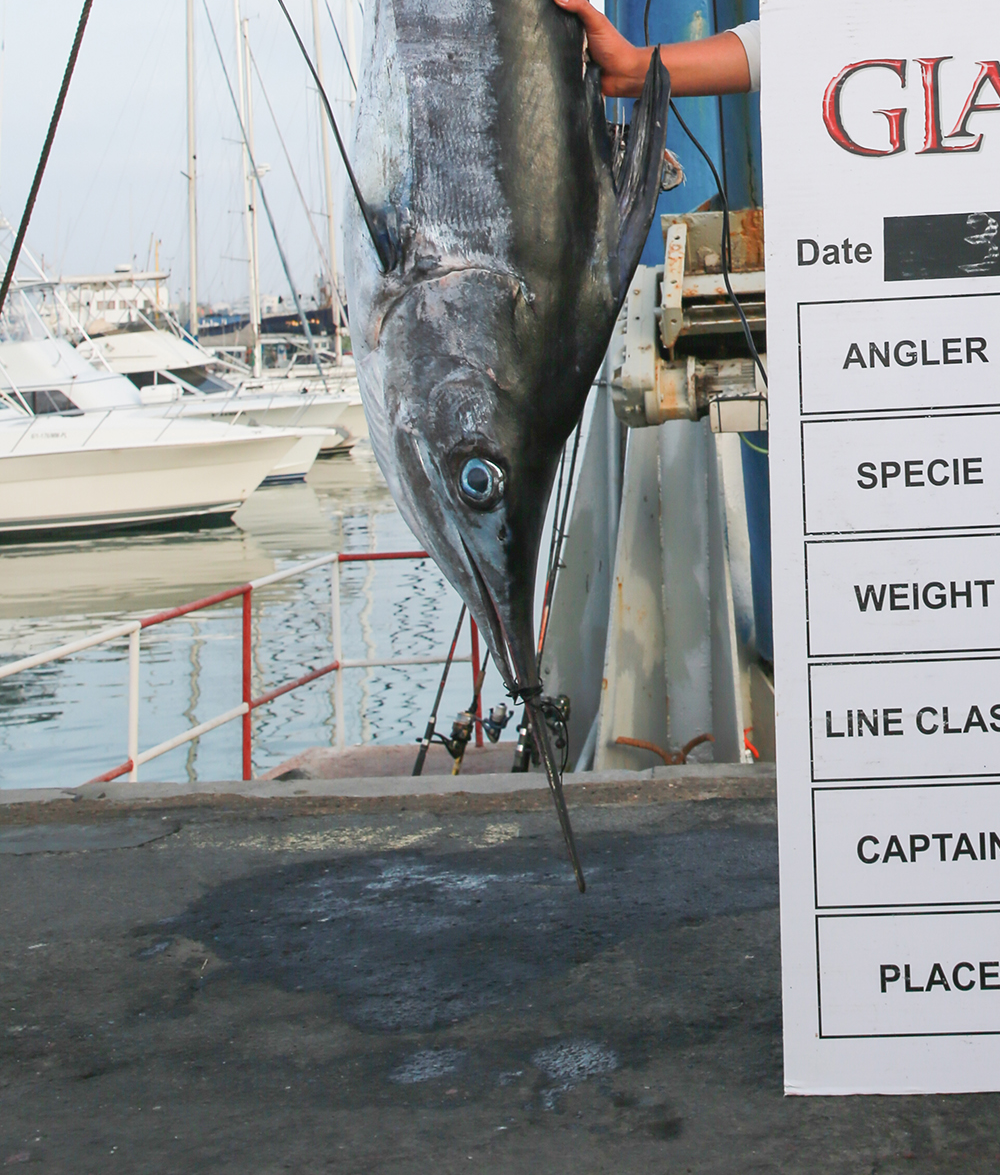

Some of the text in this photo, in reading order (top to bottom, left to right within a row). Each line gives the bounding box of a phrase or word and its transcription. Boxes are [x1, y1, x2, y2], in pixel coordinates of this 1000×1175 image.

[796, 237, 873, 267] Date
[842, 336, 990, 370] ANGLER
[856, 457, 984, 490] SPECIE
[853, 579, 996, 613] WEIGHT
[825, 707, 904, 738] LINE
[879, 961, 1000, 994] PLACE
